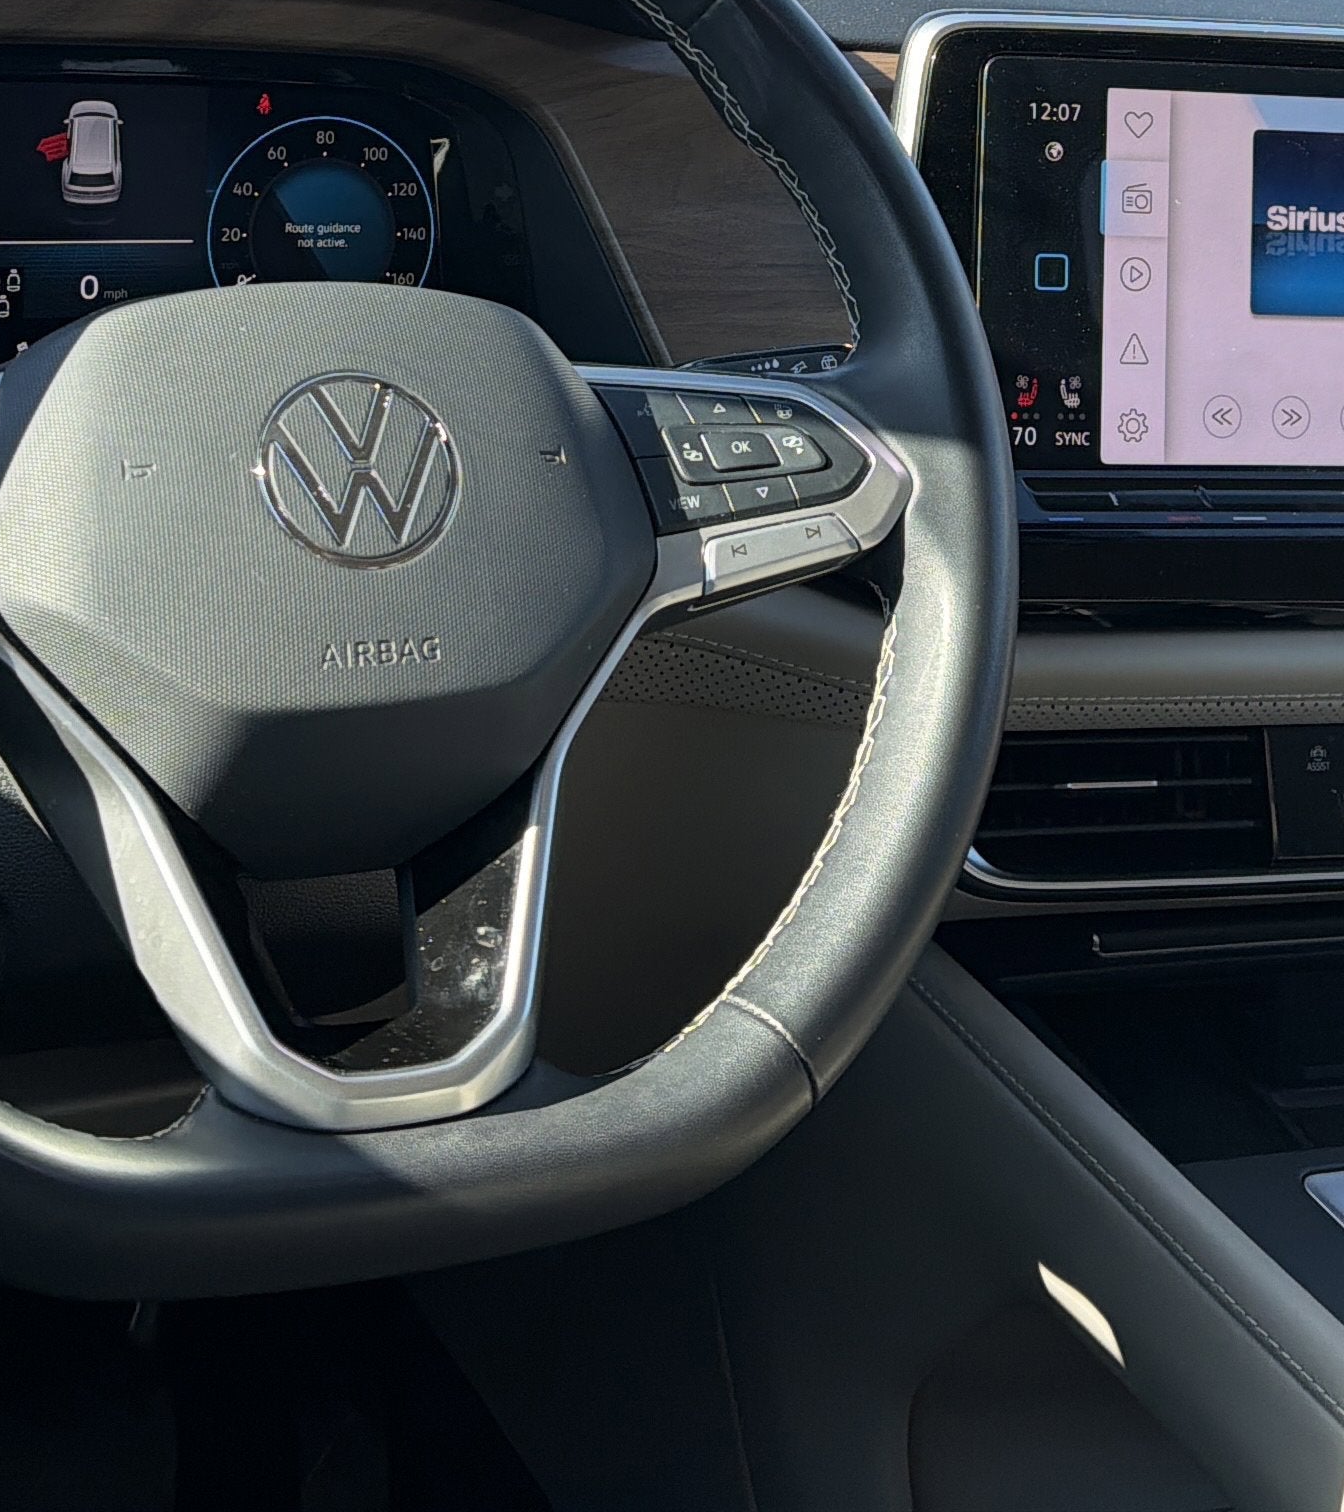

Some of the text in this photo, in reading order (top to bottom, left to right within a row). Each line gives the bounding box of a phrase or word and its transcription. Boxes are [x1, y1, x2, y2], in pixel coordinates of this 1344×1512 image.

[1029, 102, 1082, 122] 12:07
[315, 130, 335, 145] 80
[267, 146, 287, 161] 60
[362, 147, 388, 161] 100
[232, 182, 253, 197] 40
[392, 183, 418, 197] 120
[220, 227, 241, 242] 20
[285, 222, 361, 236] Route guidance
[402, 227, 426, 241] 140
[297, 238, 348, 249] not active.
[392, 272, 415, 286] 160
[80, 275, 128, 300] 0 mph
[1012, 426, 1037, 446] 70
[1055, 431, 1090, 446] SYNC
[730, 440, 752, 454] OK
[669, 494, 700, 510] VIEW
[320, 635, 442, 670] AIRBAG
[1306, 761, 1331, 772] ASSIST
